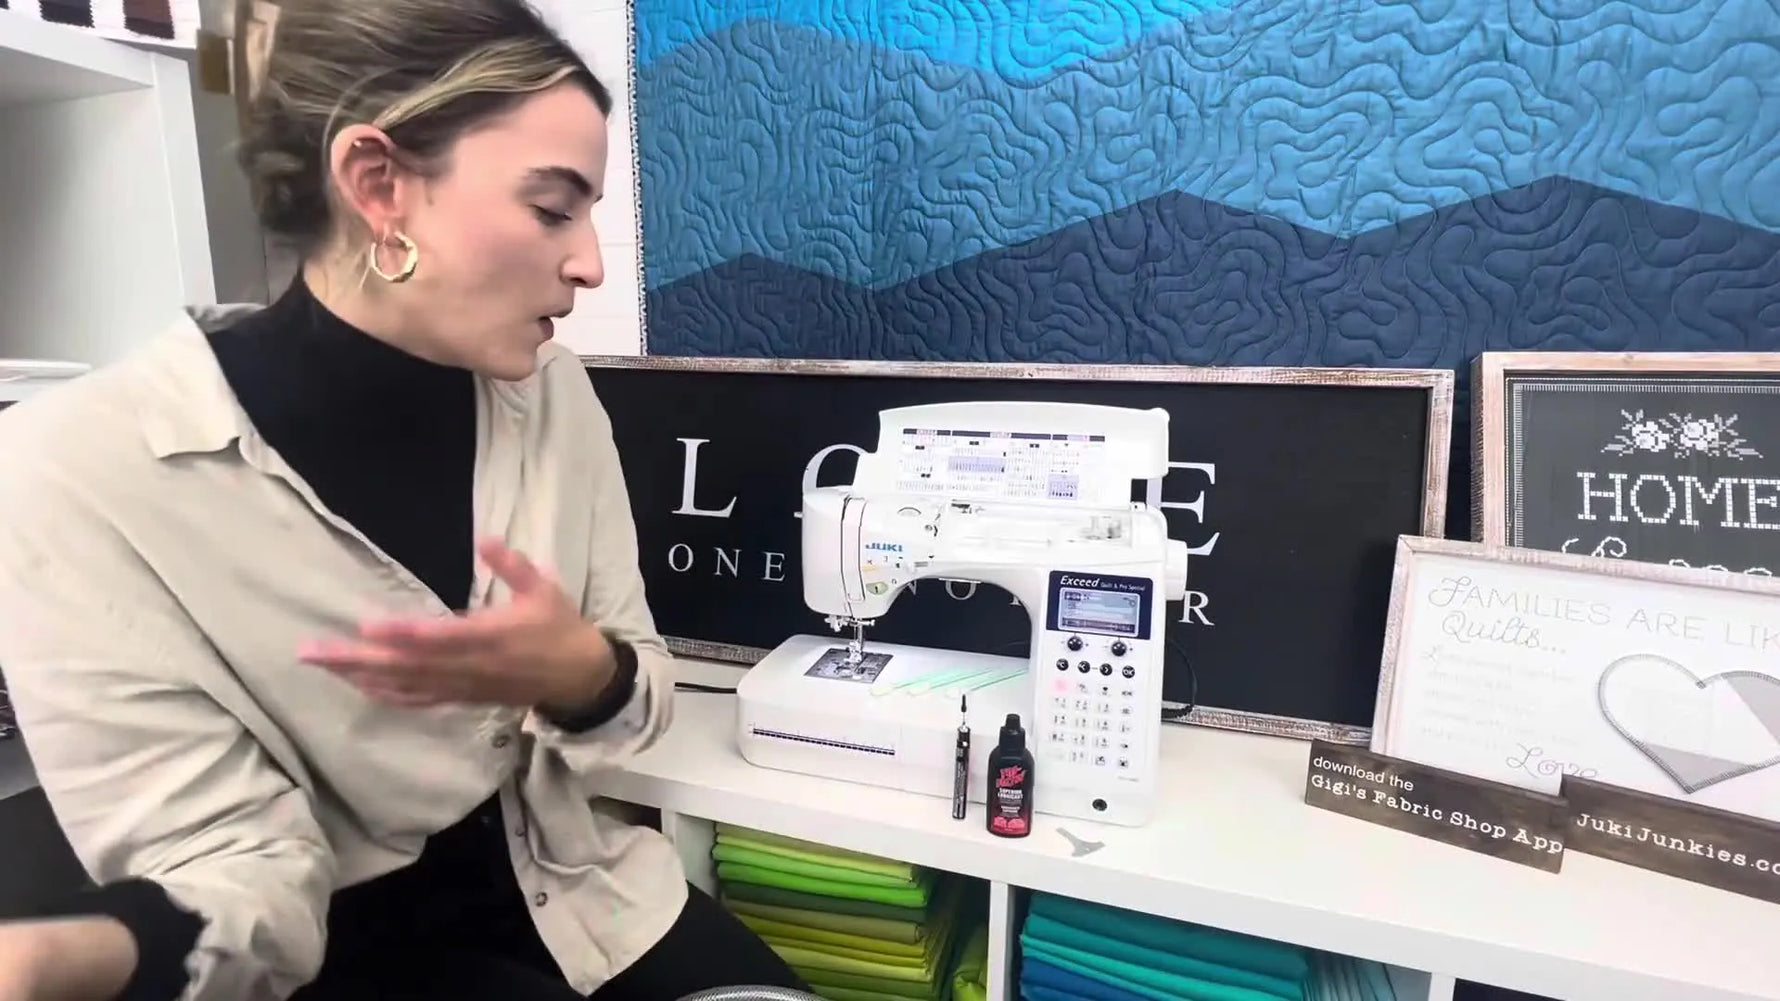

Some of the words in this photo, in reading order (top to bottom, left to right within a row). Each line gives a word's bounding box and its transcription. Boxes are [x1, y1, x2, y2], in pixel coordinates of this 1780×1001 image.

[1577, 472, 1780, 530] HOME
[668, 543, 786, 581] ONE
[865, 542, 903, 552] JUKI
[1060, 575, 1100, 587] Exceed
[1428, 576, 1611, 625] FAMILIES
[1626, 608, 1708, 640] ARE
[1313, 756, 1384, 784] download
[1389, 775, 1414, 792] the
[1311, 774, 1367, 800] Gigi's
[1372, 789, 1443, 820] Fabric
[1450, 811, 1507, 839] Shop
[1512, 828, 1563, 855] App
